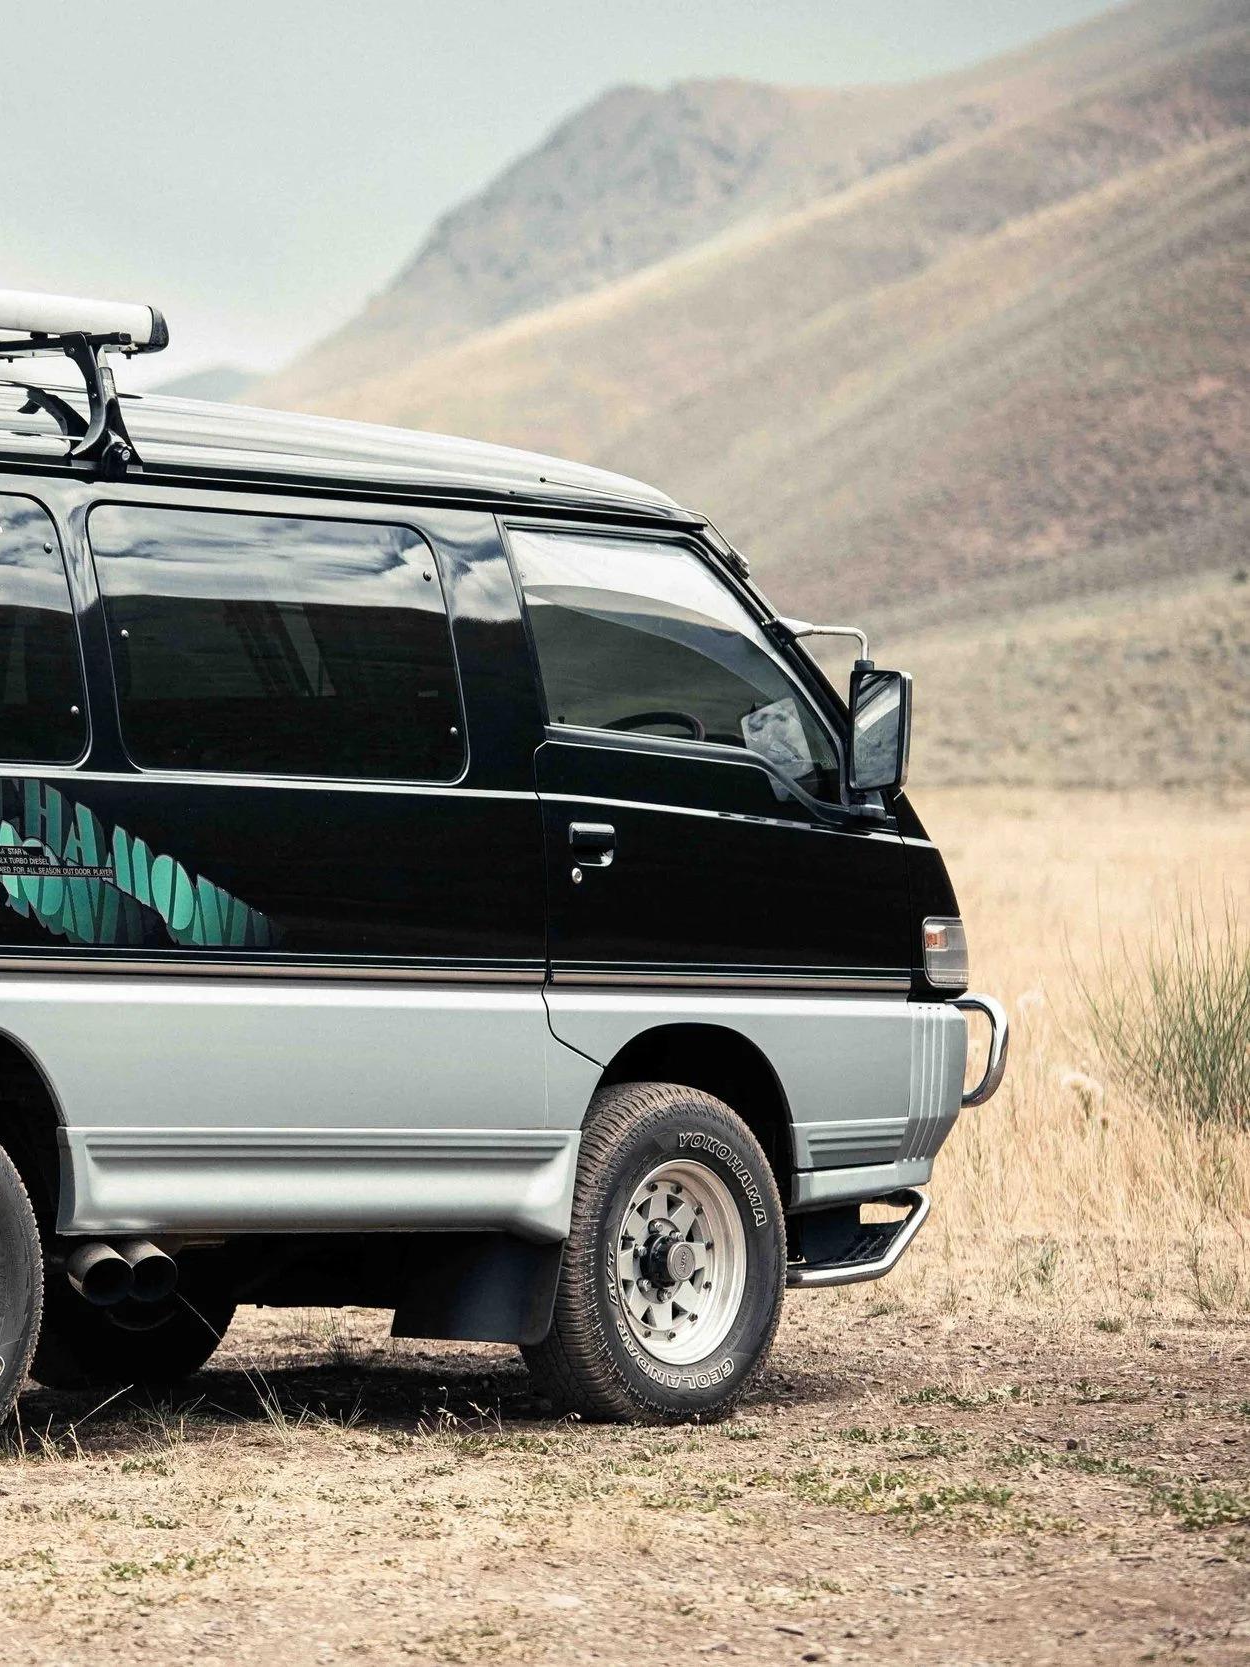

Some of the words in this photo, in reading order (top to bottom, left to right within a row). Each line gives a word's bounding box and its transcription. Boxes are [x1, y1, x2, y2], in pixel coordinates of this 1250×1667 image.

[30, 858, 50, 866] DIESEL
[678, 1132, 768, 1227] YOKOHAMA
[616, 1319, 735, 1390] GEOLANDAR
